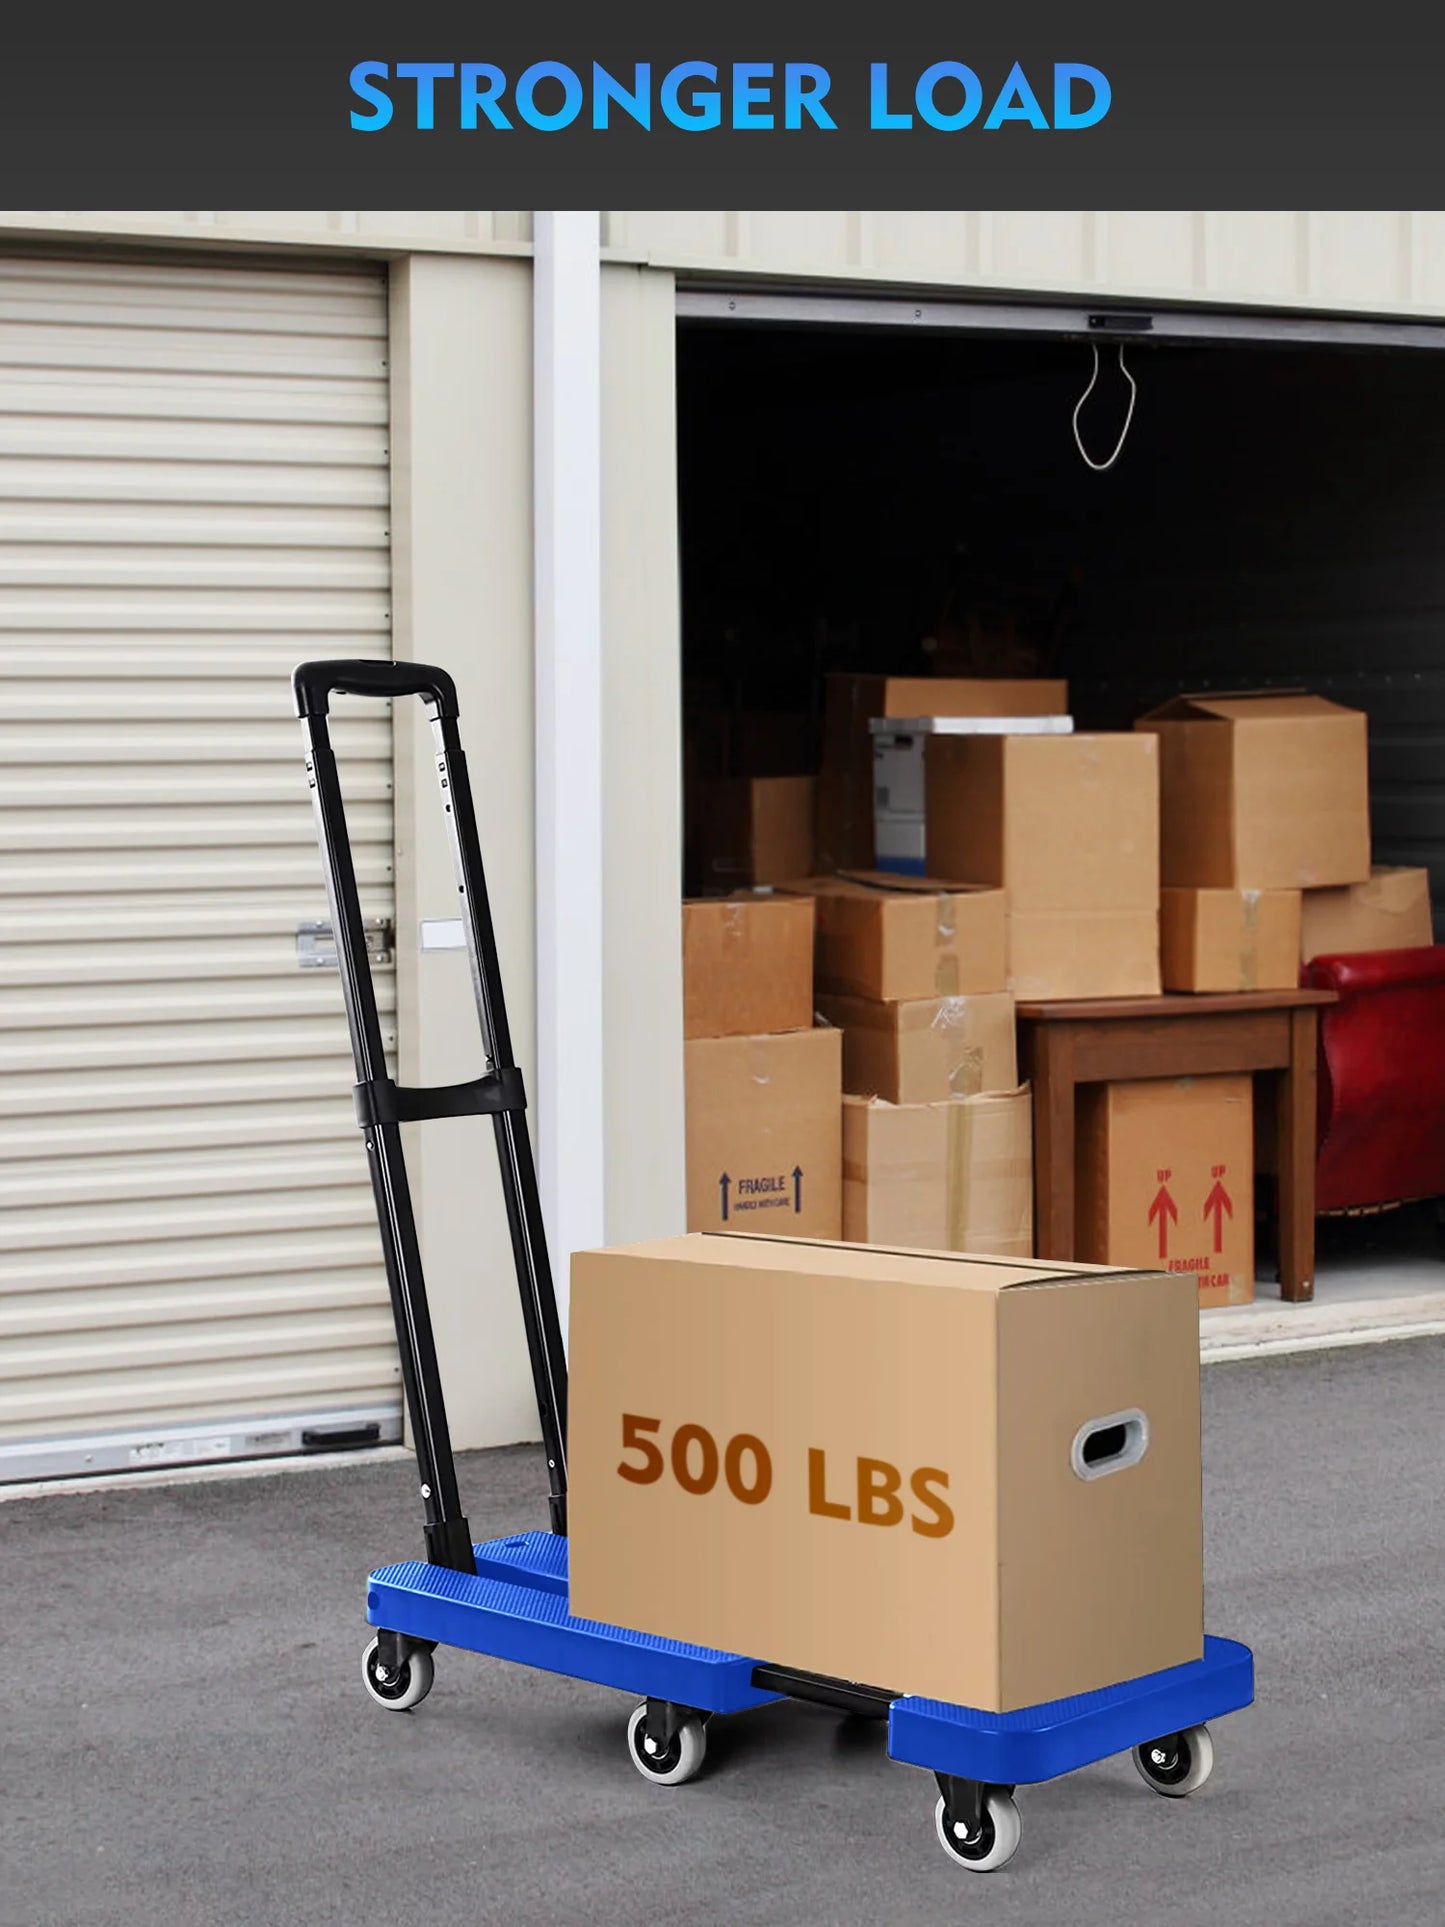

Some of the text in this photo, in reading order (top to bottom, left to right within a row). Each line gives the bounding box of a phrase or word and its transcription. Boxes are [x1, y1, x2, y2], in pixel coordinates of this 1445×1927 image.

[1156, 1169, 1172, 1183] UP
[1210, 1164, 1226, 1179] UP
[738, 1175, 785, 1194] FRAGILE
[1168, 1257, 1210, 1273] FRAGILE
[617, 1413, 955, 1539] 500 LBS
